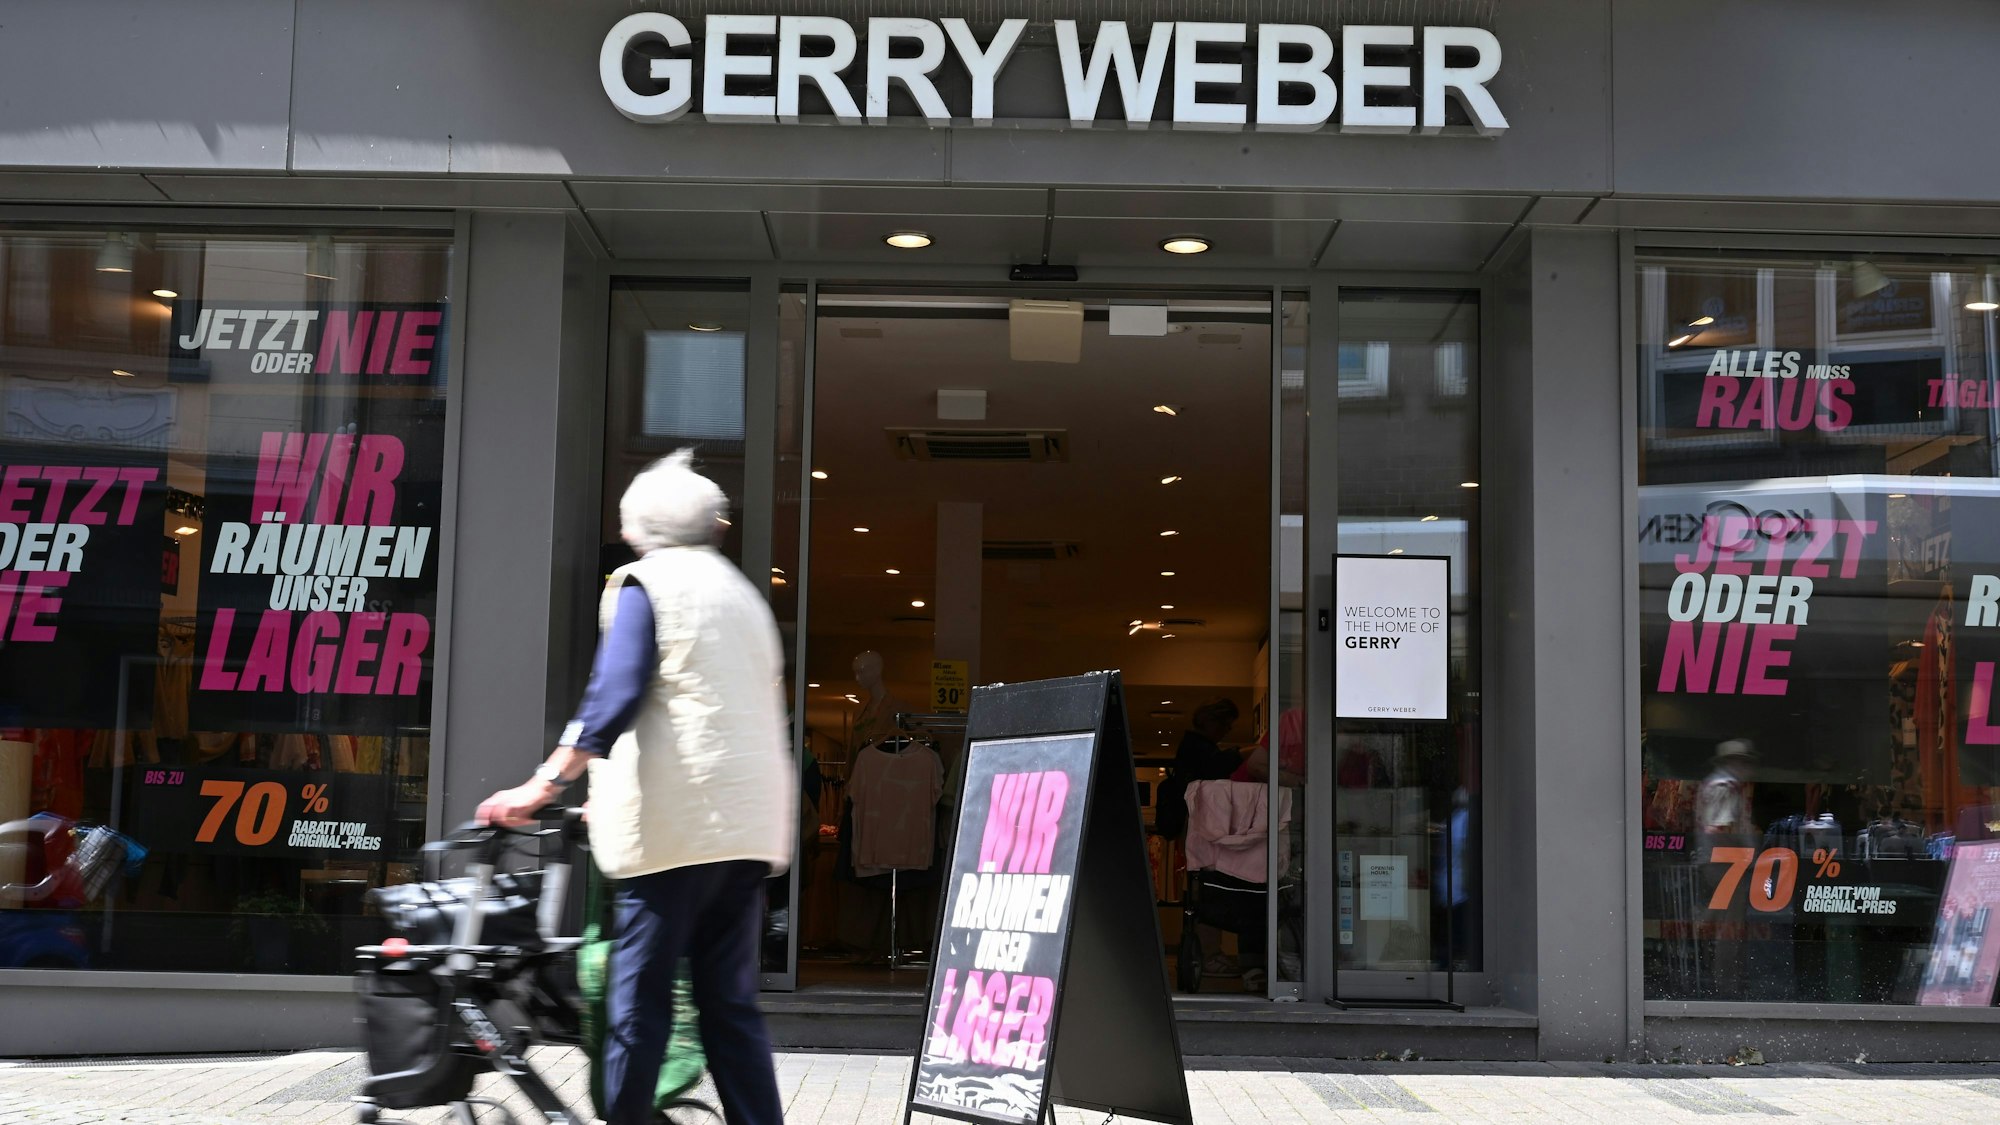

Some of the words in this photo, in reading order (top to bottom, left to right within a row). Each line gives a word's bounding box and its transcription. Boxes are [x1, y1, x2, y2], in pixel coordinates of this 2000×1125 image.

[599, 12, 1029, 122] GERRY
[1054, 20, 1511, 131] WEBER
[179, 309, 319, 350] JETZT
[314, 311, 442, 374] NIE
[250, 352, 314, 374] ODER
[1706, 350, 1801, 379] ALLES
[1805, 364, 1851, 379] MUSS
[1696, 376, 1856, 431] RAUS
[0, 466, 159, 525] ETZT
[250, 432, 405, 526] WIR
[210, 512, 431, 578] RÄUMEN
[1674, 515, 1878, 578] JETZT
[0, 571, 71, 642] IE
[269, 575, 369, 612] UNSER
[1344, 606, 1417, 618] WELCOME
[1421, 608, 1441, 619] TO
[1667, 572, 1814, 625] ODER
[199, 608, 431, 695] LAGER
[1345, 620, 1371, 632] THE
[1375, 621, 1417, 632] HOME
[1420, 622, 1440, 633] OF
[1345, 636, 1401, 649] GERRY
[1657, 621, 1799, 696] NIE
[144, 770, 165, 785] BIS
[167, 771, 184, 785] ZU
[195, 780, 287, 846] 70
[301, 784, 329, 814] %
[292, 820, 338, 836] RABATT
[338, 821, 367, 836] VOM
[977, 770, 1070, 873] WIR
[288, 834, 381, 851] ORIGINAL-PREIS
[1645, 836, 1665, 850] BIS
[1668, 836, 1684, 850] ZU
[951, 861, 1071, 933] RÄUMEN
[1708, 847, 1799, 912] 70
[1812, 848, 1841, 878] %
[1806, 885, 1852, 900] RABATT
[1853, 886, 1880, 900] VOM
[1803, 899, 1897, 915] ORIGINAL-PREIS
[974, 930, 1031, 973] UNSER
[928, 969, 1055, 1072] LAGER
